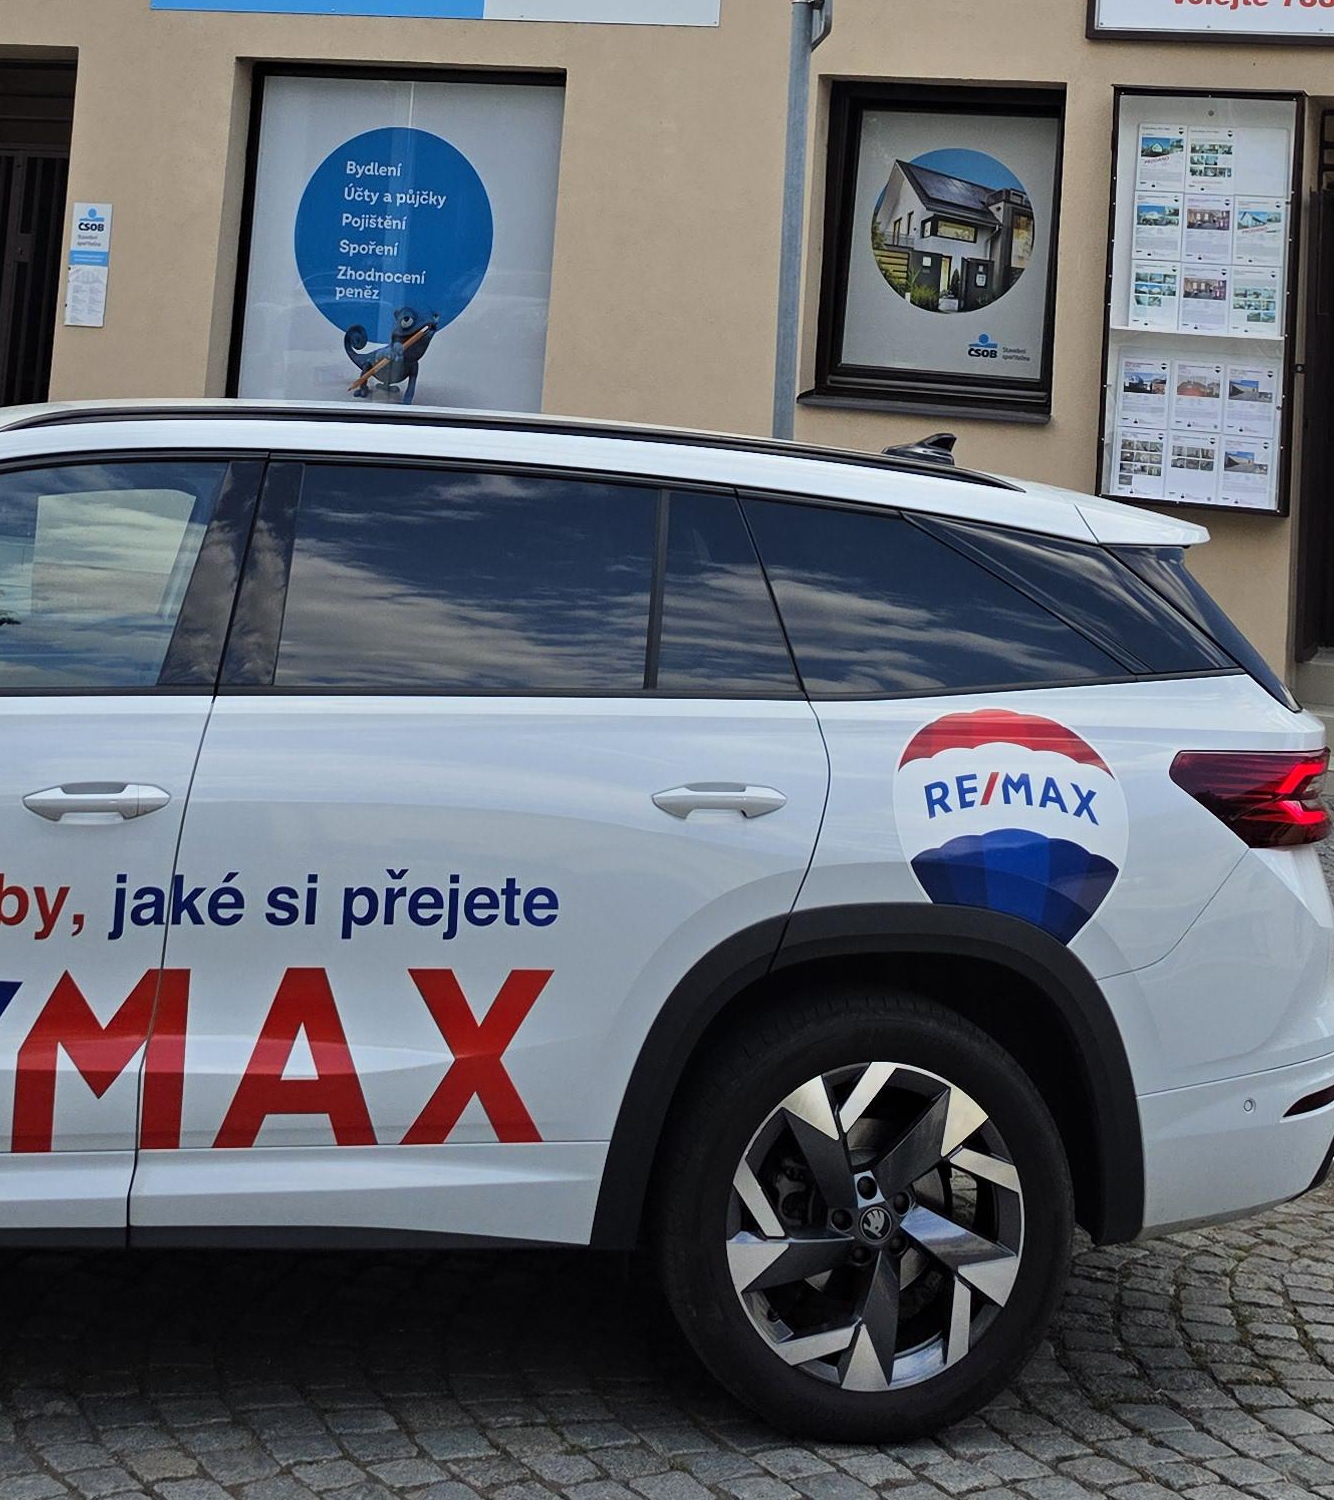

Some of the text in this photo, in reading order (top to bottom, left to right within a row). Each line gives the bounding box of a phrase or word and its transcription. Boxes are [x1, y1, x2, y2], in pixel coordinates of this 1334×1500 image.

[346, 161, 402, 178] Bydlení
[344, 184, 446, 209] Účty a půjčky
[342, 213, 407, 231] Pojištění
[339, 240, 398, 257] Spoření
[337, 266, 426, 284] Zhodnocení
[336, 285, 379, 300] peněz
[924, 772, 1099, 826] RE/MAX
[108, 872, 245, 941] jaké
[265, 874, 319, 926] si
[341, 868, 560, 941] přejete
